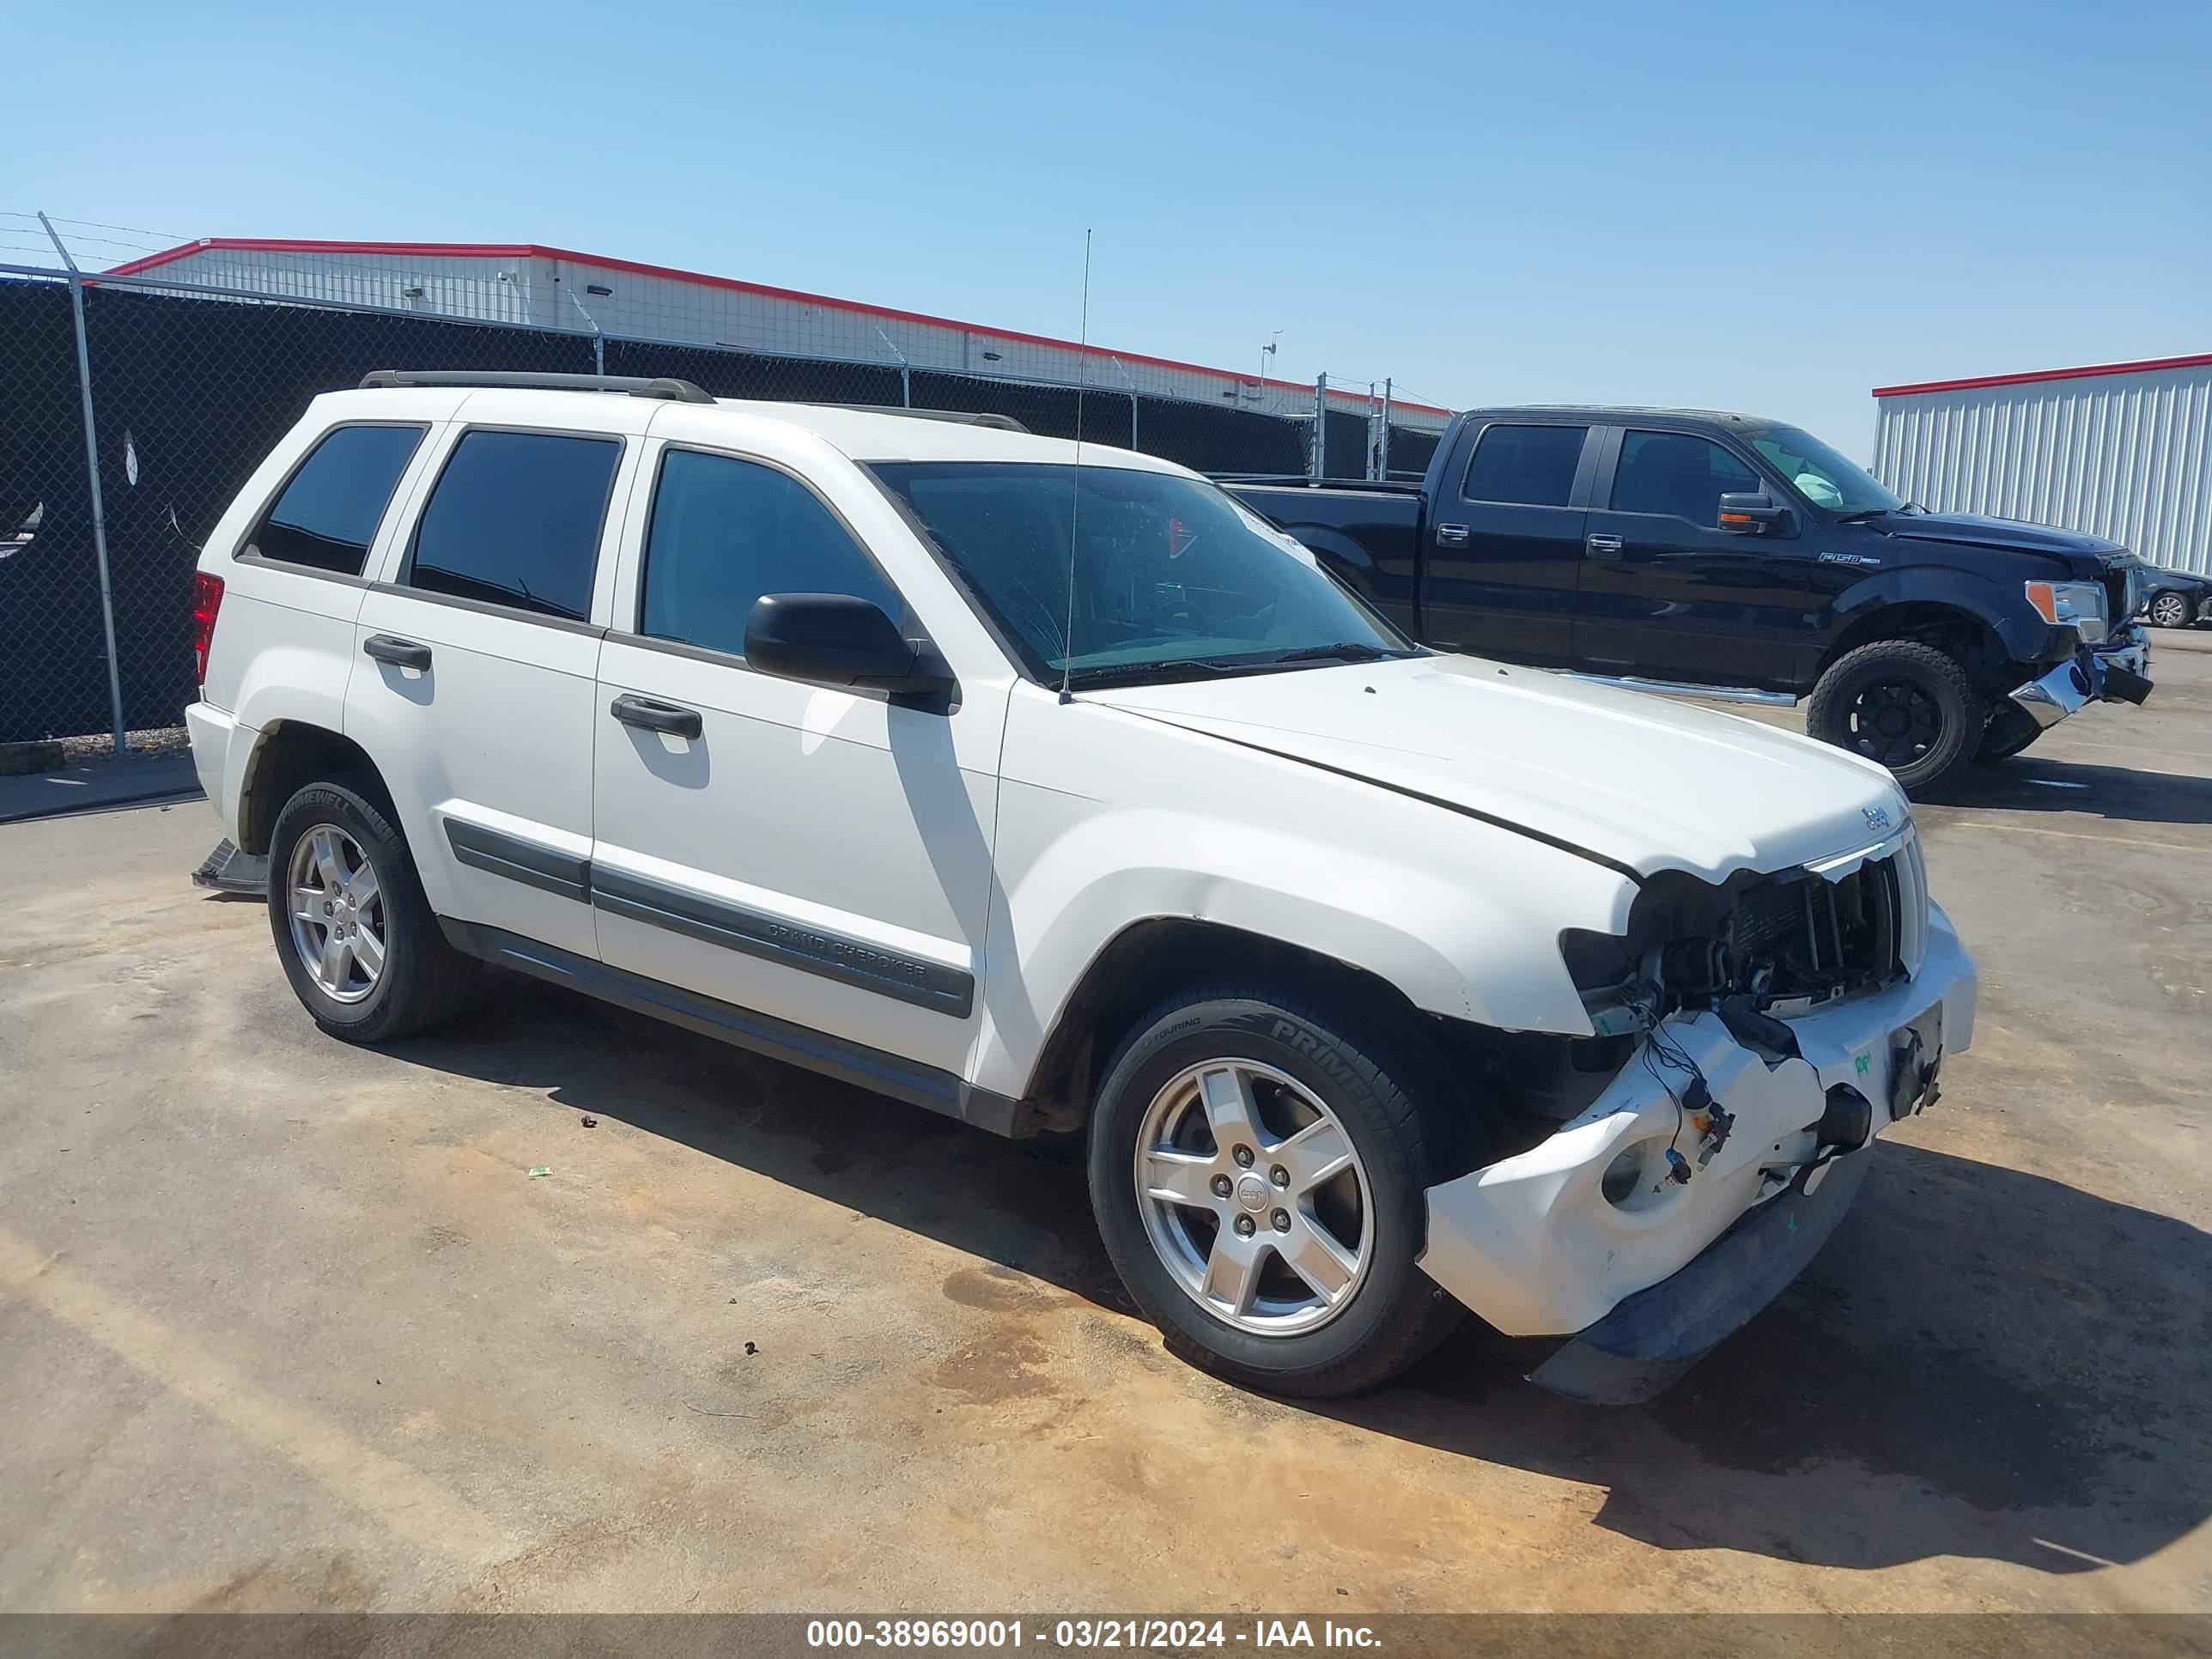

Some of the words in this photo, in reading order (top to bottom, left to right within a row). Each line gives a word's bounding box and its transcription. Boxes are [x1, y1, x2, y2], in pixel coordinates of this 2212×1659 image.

[768, 923, 827, 950] GRAND
[833, 942, 927, 977] CHEROKEE
[1153, 1017, 1202, 1042] TOURING
[1270, 1018, 1403, 1170] PRIMEW
